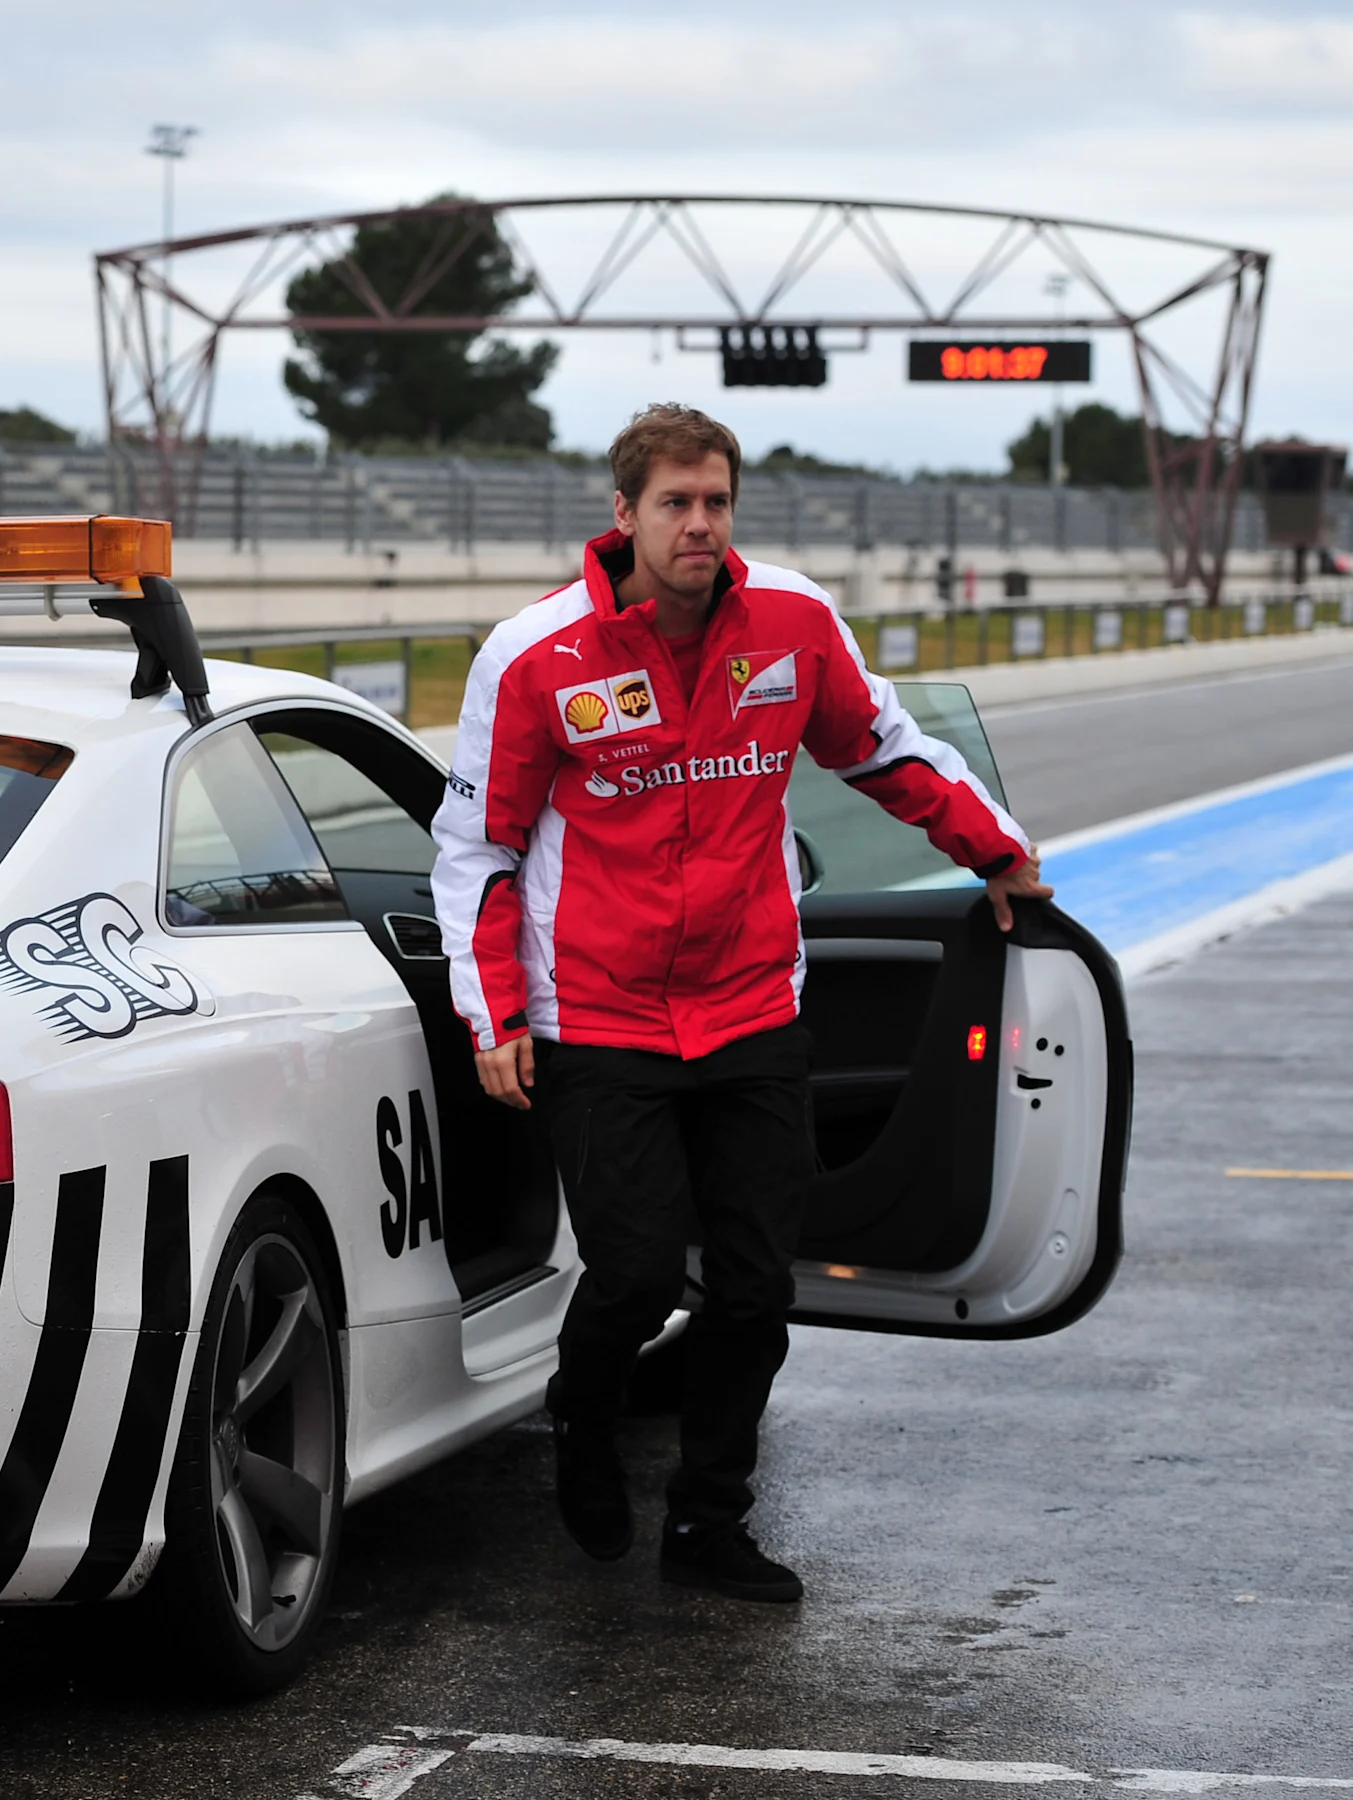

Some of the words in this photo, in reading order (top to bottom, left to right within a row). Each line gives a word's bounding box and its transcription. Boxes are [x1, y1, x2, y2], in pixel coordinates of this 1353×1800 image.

[618, 690, 650, 715] ups
[612, 743, 650, 758] VETTEL
[621, 740, 789, 796] Santander
